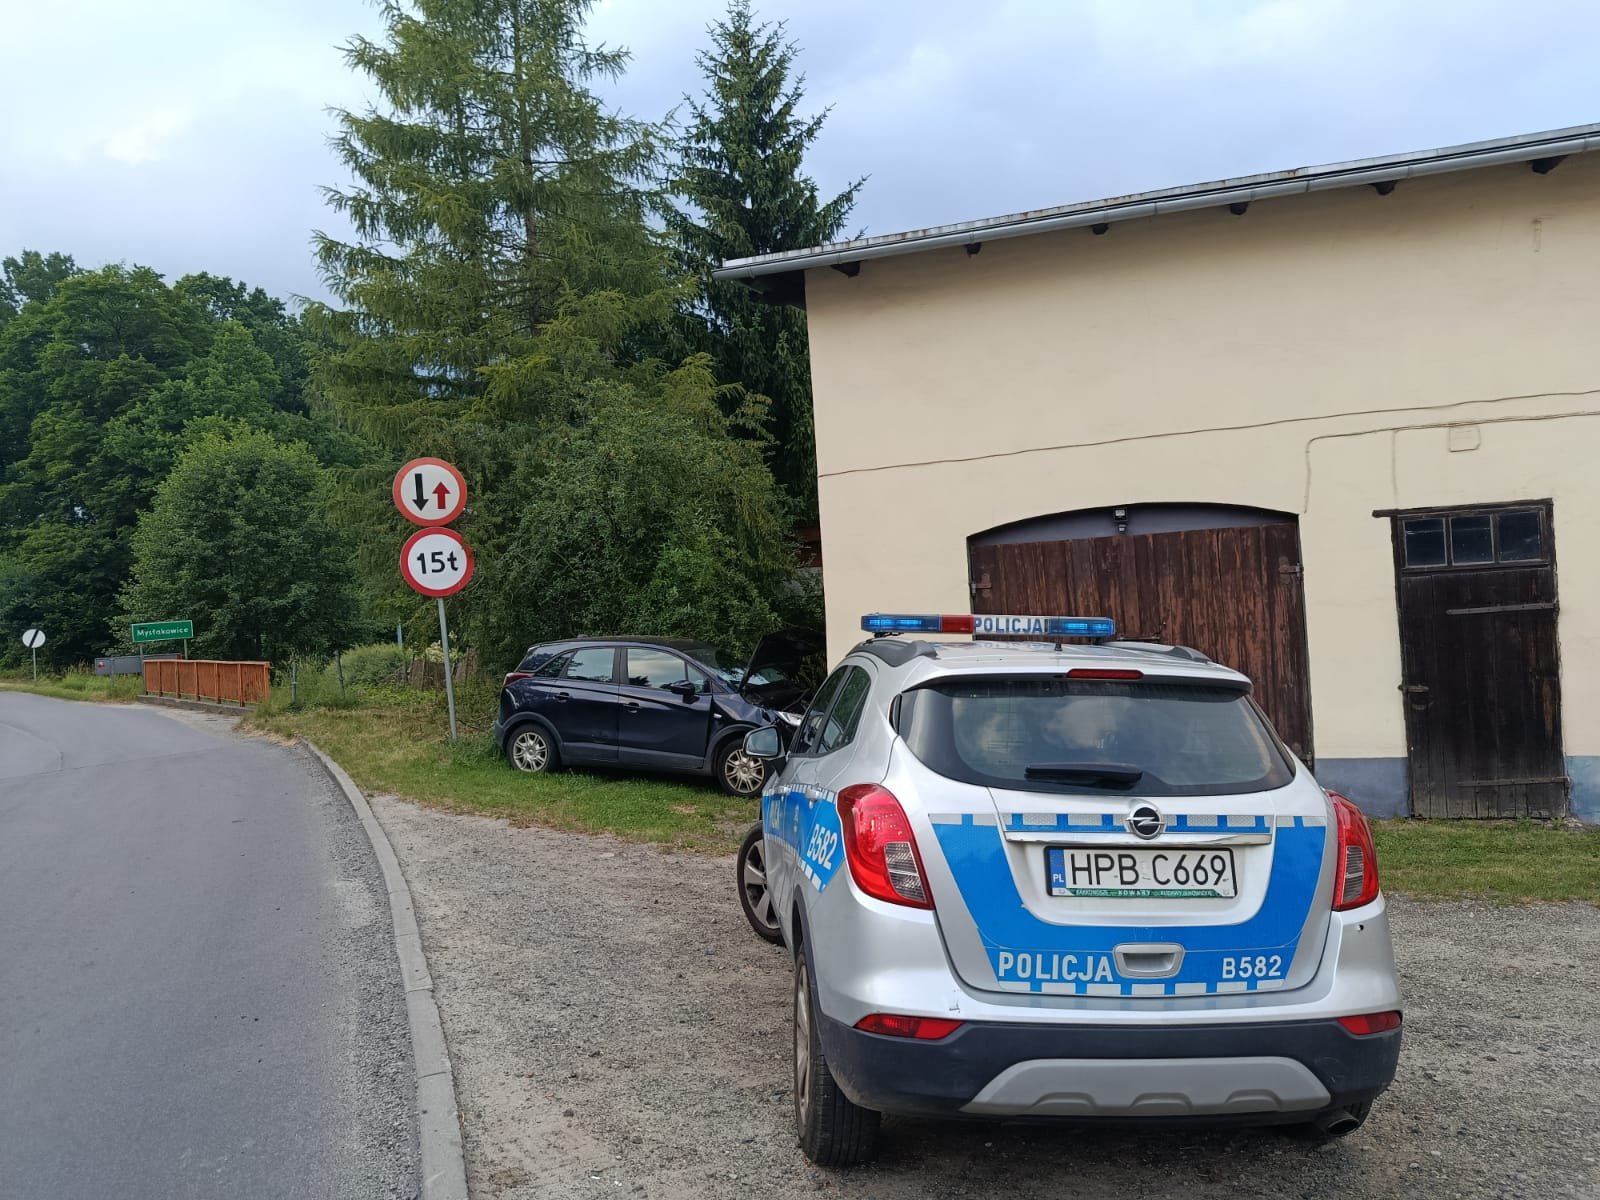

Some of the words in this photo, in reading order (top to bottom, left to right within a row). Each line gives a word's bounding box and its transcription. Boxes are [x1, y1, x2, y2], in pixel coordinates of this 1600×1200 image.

[417, 550, 458, 574] 15t
[974, 617, 1045, 634] POLICJA
[806, 823, 838, 870] B582
[1053, 873, 1065, 883] PL
[1070, 852, 1139, 886] HPB
[1152, 853, 1226, 886] C669
[998, 952, 1114, 983] POLICJA
[1222, 955, 1282, 979] B582
